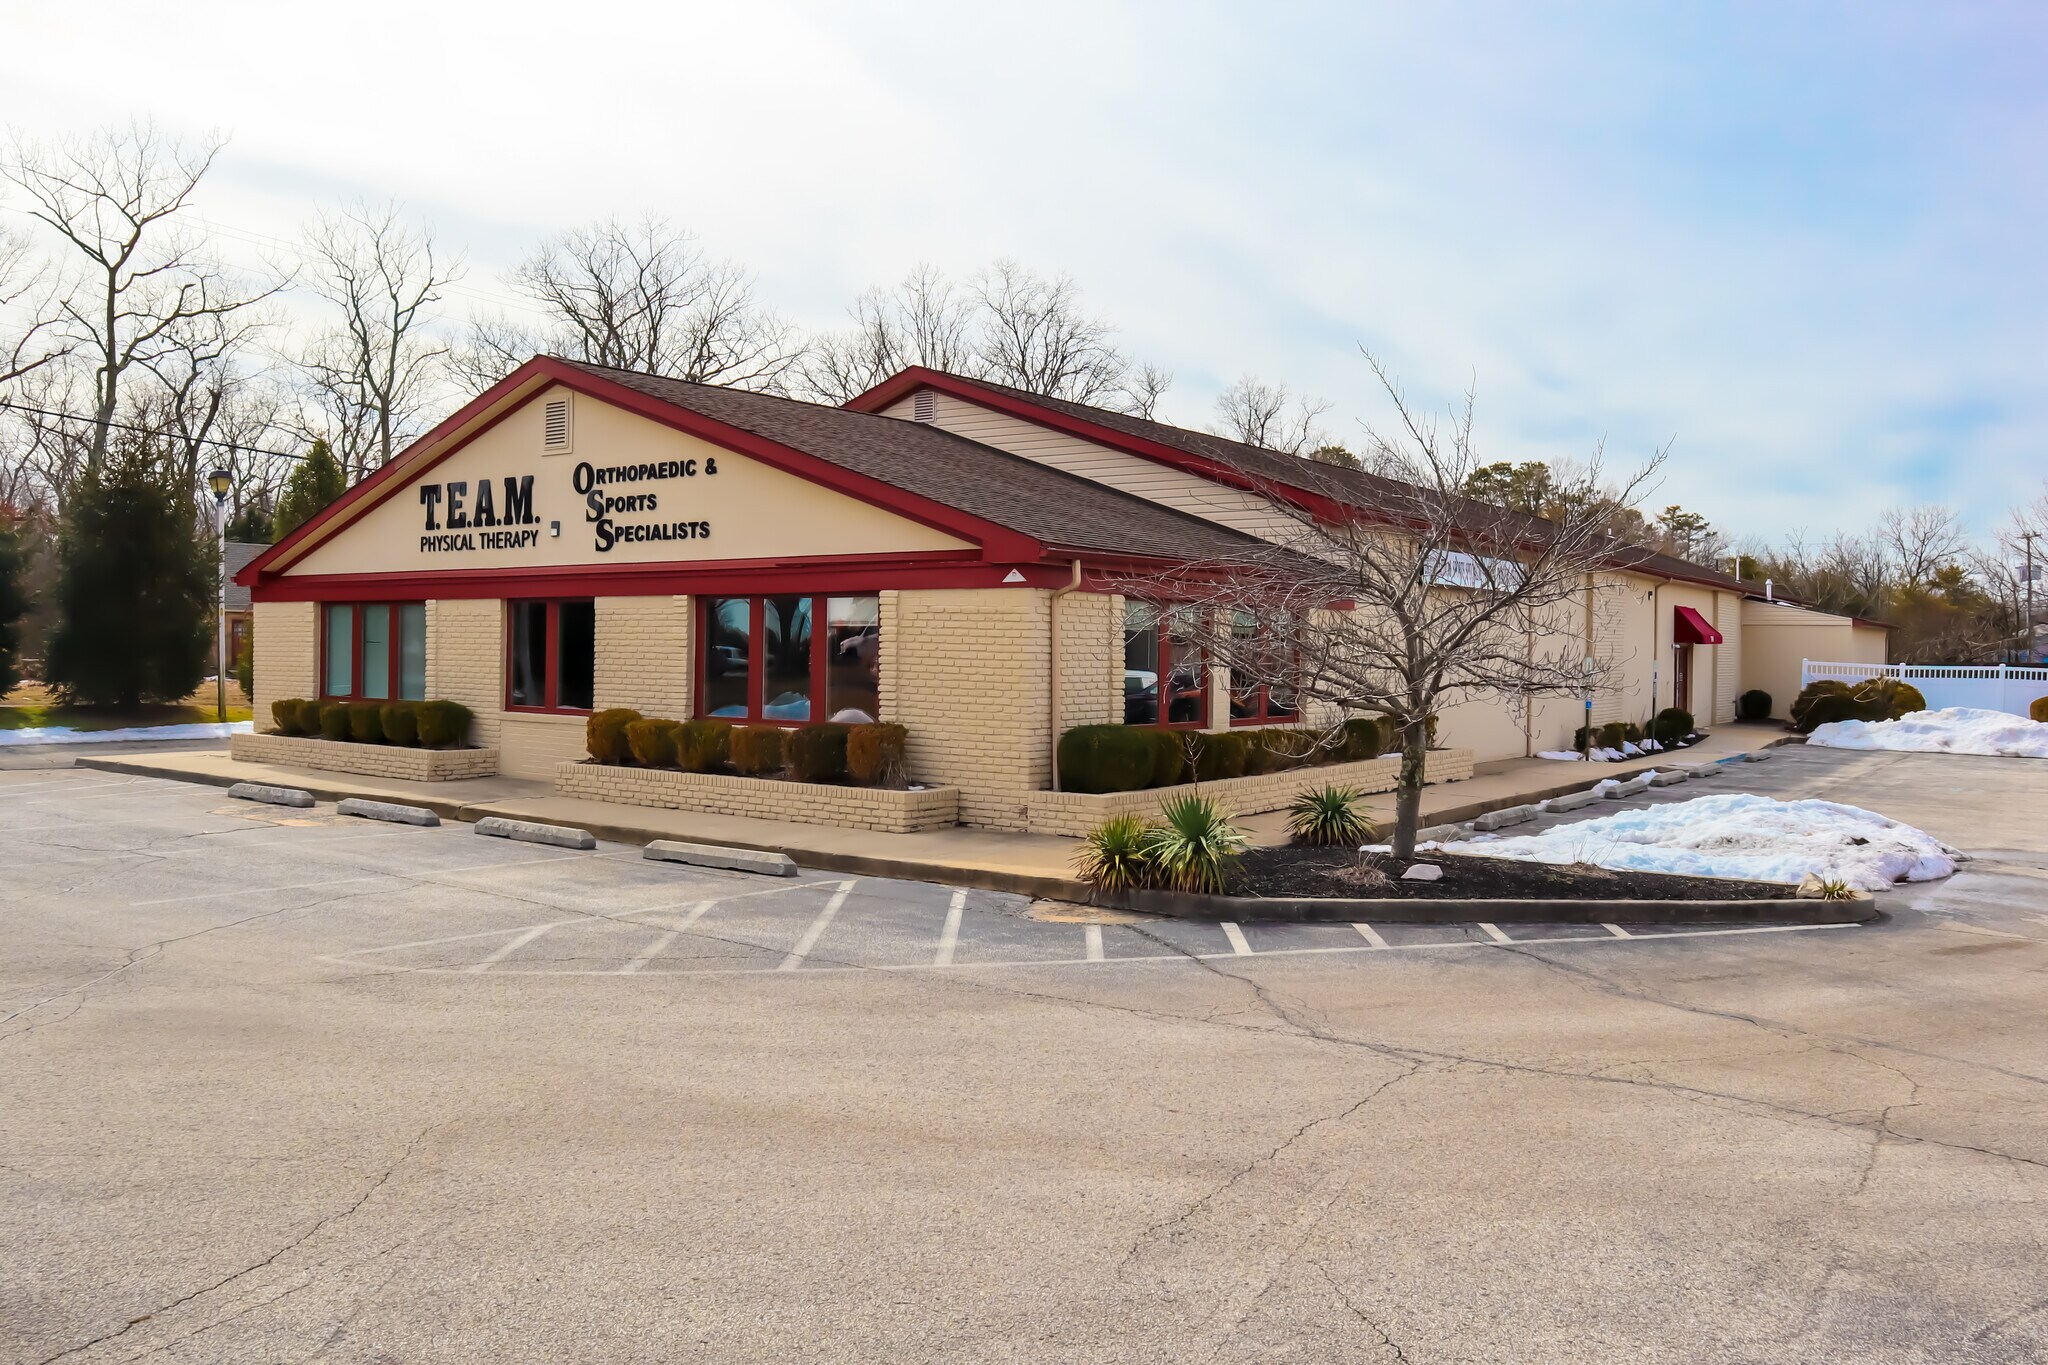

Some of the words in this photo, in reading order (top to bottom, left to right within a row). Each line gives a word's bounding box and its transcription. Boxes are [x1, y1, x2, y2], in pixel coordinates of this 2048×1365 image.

[572, 460, 697, 495] ORTHOPAEDIC
[704, 457, 718, 475] &
[420, 474, 541, 530] T.E.A.M.
[585, 489, 658, 522] SPORTS
[420, 531, 476, 552] PHYSICAL
[479, 529, 539, 549] THERAPY
[595, 518, 711, 552] SPECIALISTS
